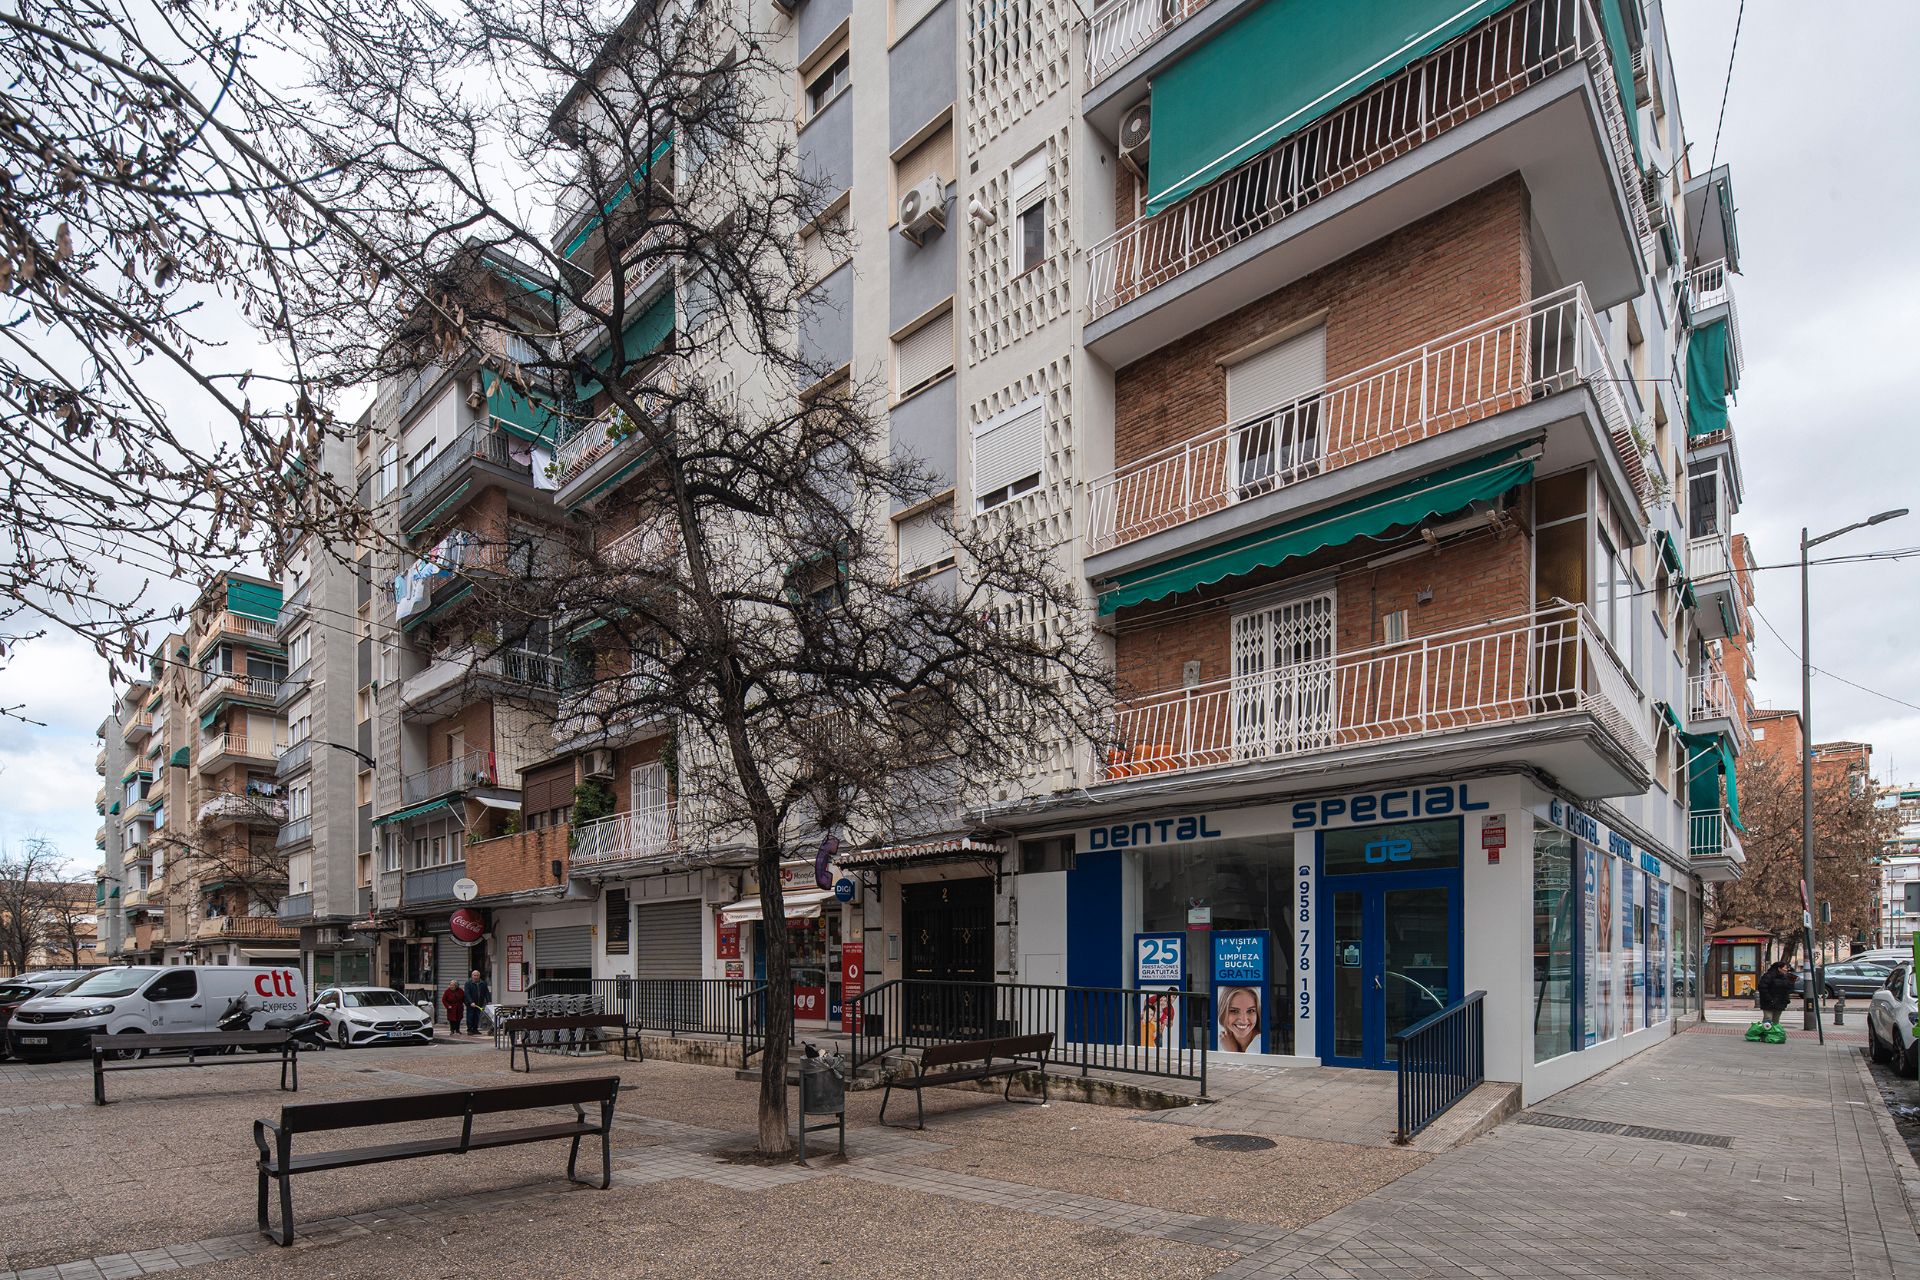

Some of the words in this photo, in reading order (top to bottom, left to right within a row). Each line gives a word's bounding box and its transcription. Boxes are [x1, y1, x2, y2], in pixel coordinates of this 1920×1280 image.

[1299, 881, 1310, 922] 958
[1142, 940, 1178, 964] 25
[1219, 953, 1260, 961] LIMPIEZA
[1300, 930, 1310, 971] 778
[254, 969, 296, 997] ctt
[1218, 969, 1261, 979] GRATIS
[262, 1001, 298, 1013] Express
[1300, 978, 1310, 1019] 192
